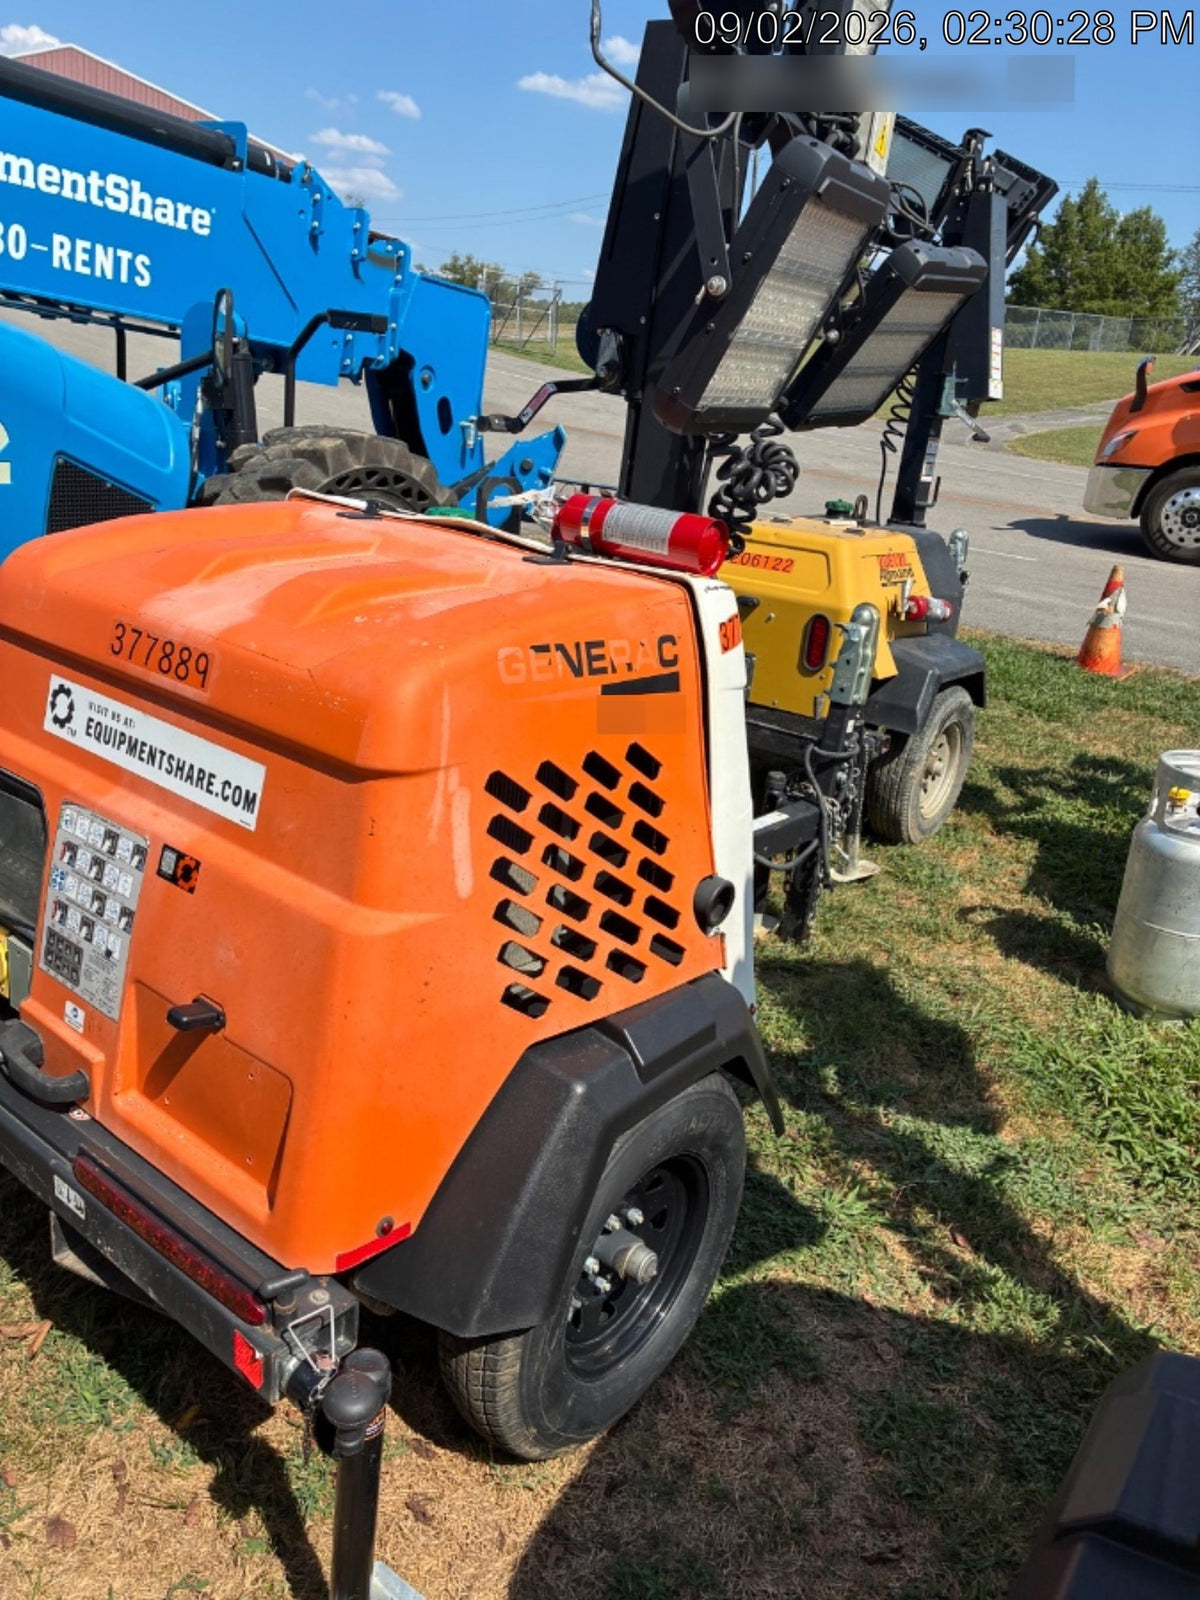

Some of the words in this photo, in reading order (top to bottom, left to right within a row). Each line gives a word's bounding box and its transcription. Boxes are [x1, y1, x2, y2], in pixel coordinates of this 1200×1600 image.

[110, 622, 210, 689] 377889
[497, 634, 678, 685] GENERAC
[85, 716, 258, 815] EQUIPMENTSHARE.COM
